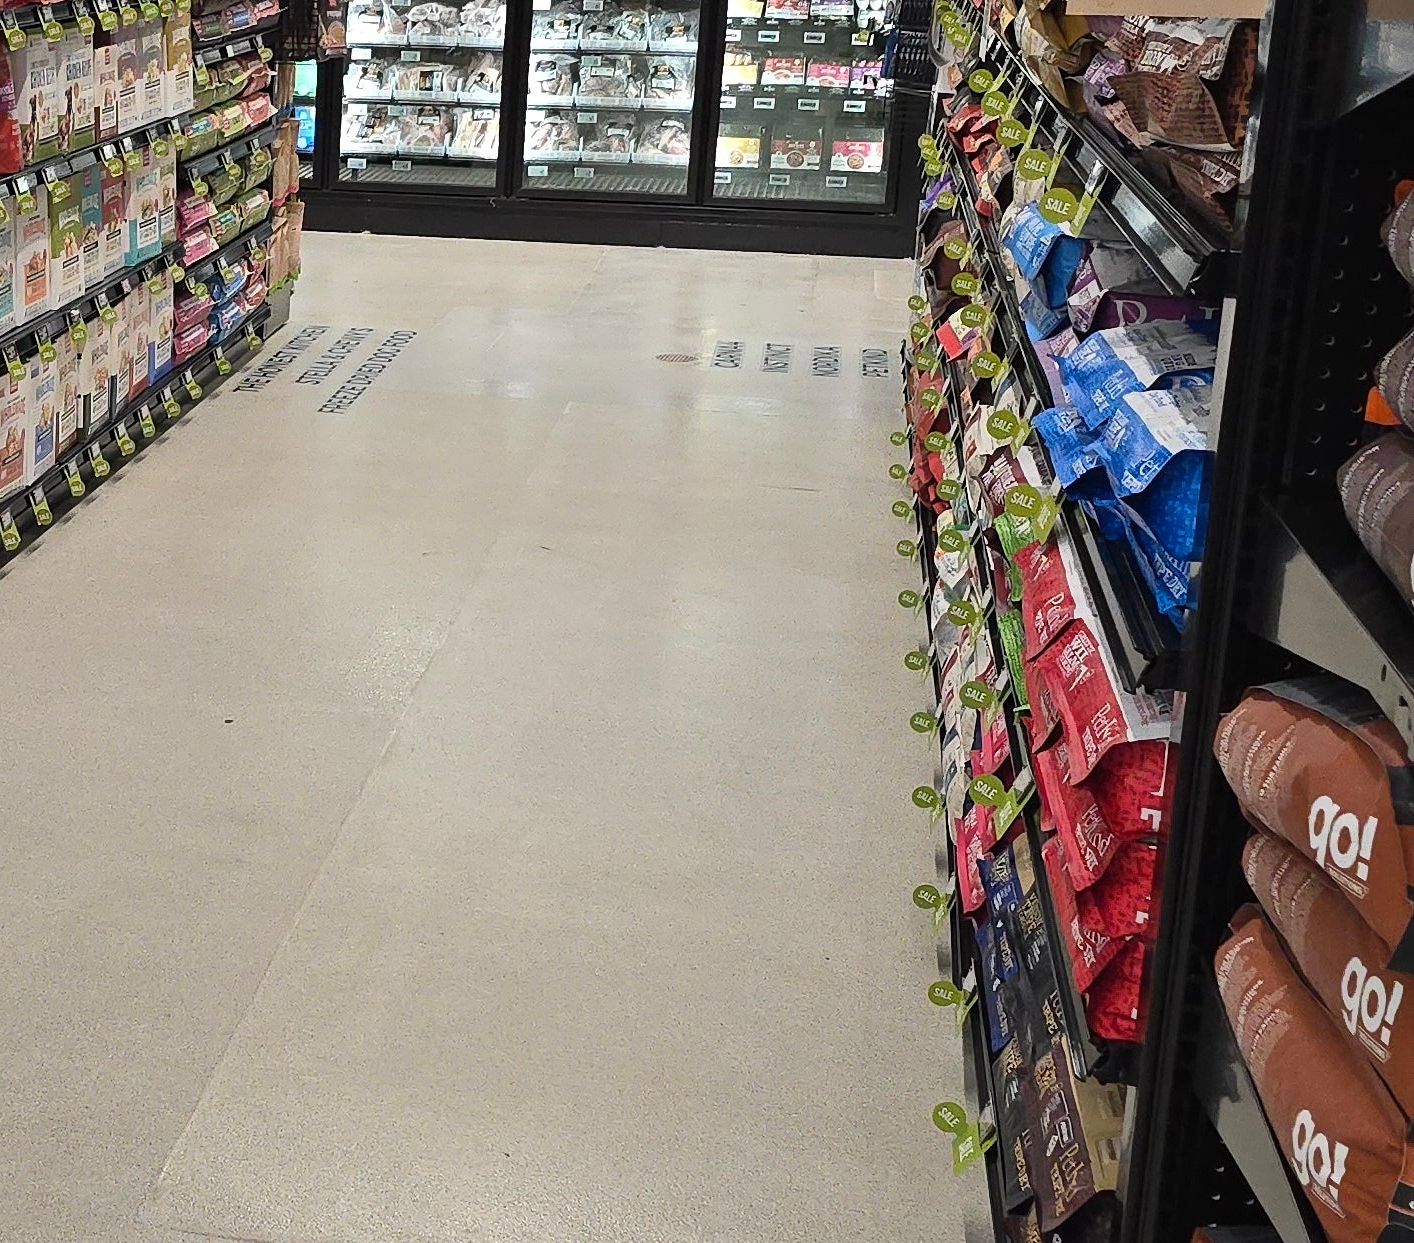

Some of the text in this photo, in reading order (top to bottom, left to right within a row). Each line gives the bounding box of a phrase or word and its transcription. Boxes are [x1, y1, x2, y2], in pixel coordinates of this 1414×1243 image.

[1001, 127, 1020, 141] SALE
[1024, 158, 1046, 173] SALE
[1045, 197, 1070, 216] SALE
[955, 278, 973, 291] SALE
[964, 309, 982, 322] SALE
[975, 356, 997, 370] SALE
[991, 418, 1014, 433] SALE
[940, 484, 957, 496] SALE
[1011, 495, 1036, 510] SALE
[942, 534, 961, 549] SALE
[951, 608, 970, 620] SALE
[909, 656, 924, 666] SALE
[965, 687, 987, 704] SALE
[916, 792, 934, 803] SALE
[974, 780, 999, 801] SALE
[1308, 795, 1378, 881] go!
[917, 892, 937, 904] SALE
[932, 989, 954, 1000] SALE
[1341, 956, 1404, 1046] go!
[938, 1108, 959, 1127] SALE
[1292, 1109, 1349, 1200] go!
